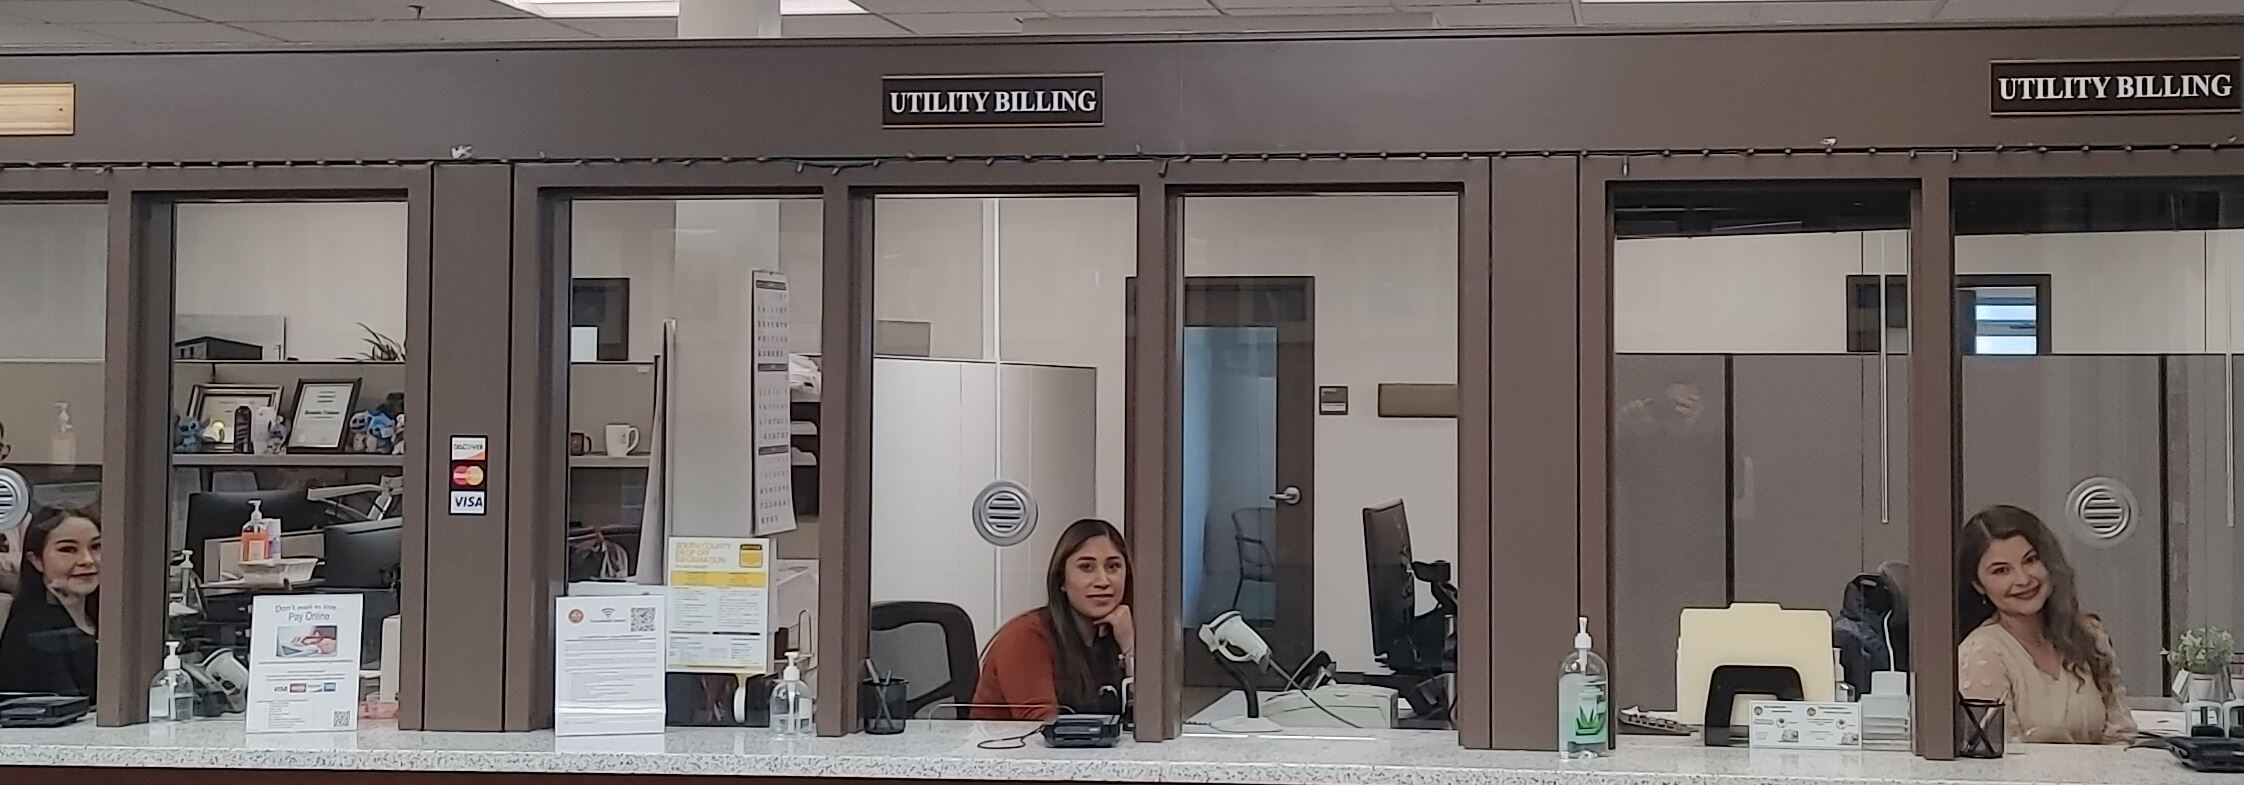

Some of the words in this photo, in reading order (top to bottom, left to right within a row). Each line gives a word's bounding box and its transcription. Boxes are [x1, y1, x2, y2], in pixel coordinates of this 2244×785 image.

[1997, 76, 2111, 100] UTILITY
[2116, 73, 2233, 98] BILLING
[889, 91, 990, 113] UTILITY
[994, 90, 1097, 112] BILLING
[455, 496, 483, 507] VISA
[288, 612, 304, 623] Pay
[305, 611, 330, 621] Online
